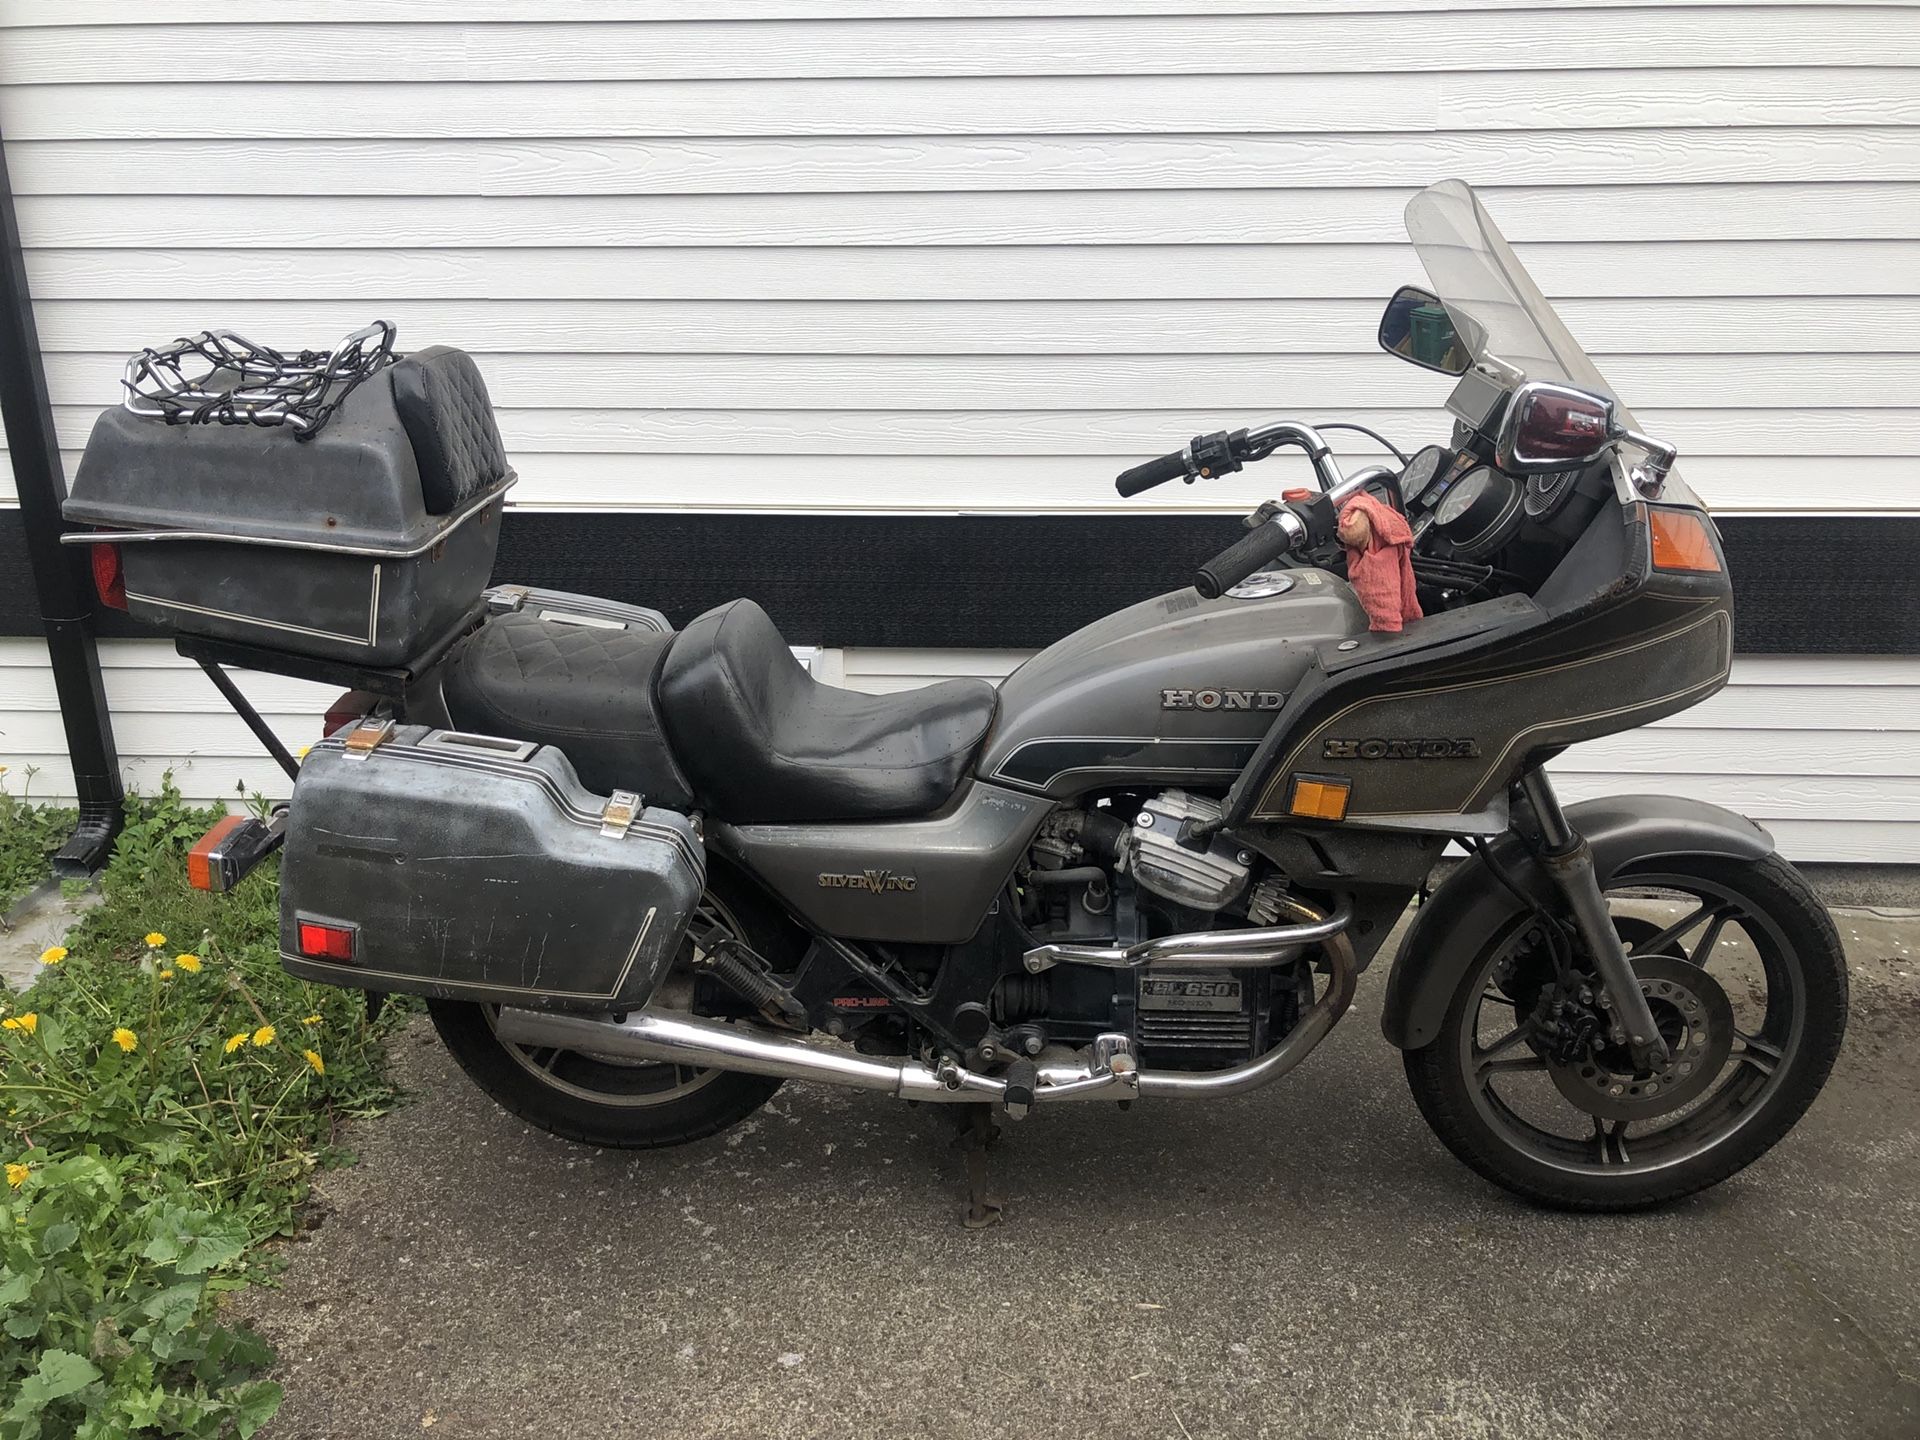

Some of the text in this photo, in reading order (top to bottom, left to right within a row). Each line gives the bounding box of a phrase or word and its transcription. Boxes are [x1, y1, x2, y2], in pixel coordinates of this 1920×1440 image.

[1162, 690, 1285, 709] HOND
[1324, 739, 1481, 759] HONDA
[1185, 982, 1230, 996] 650
